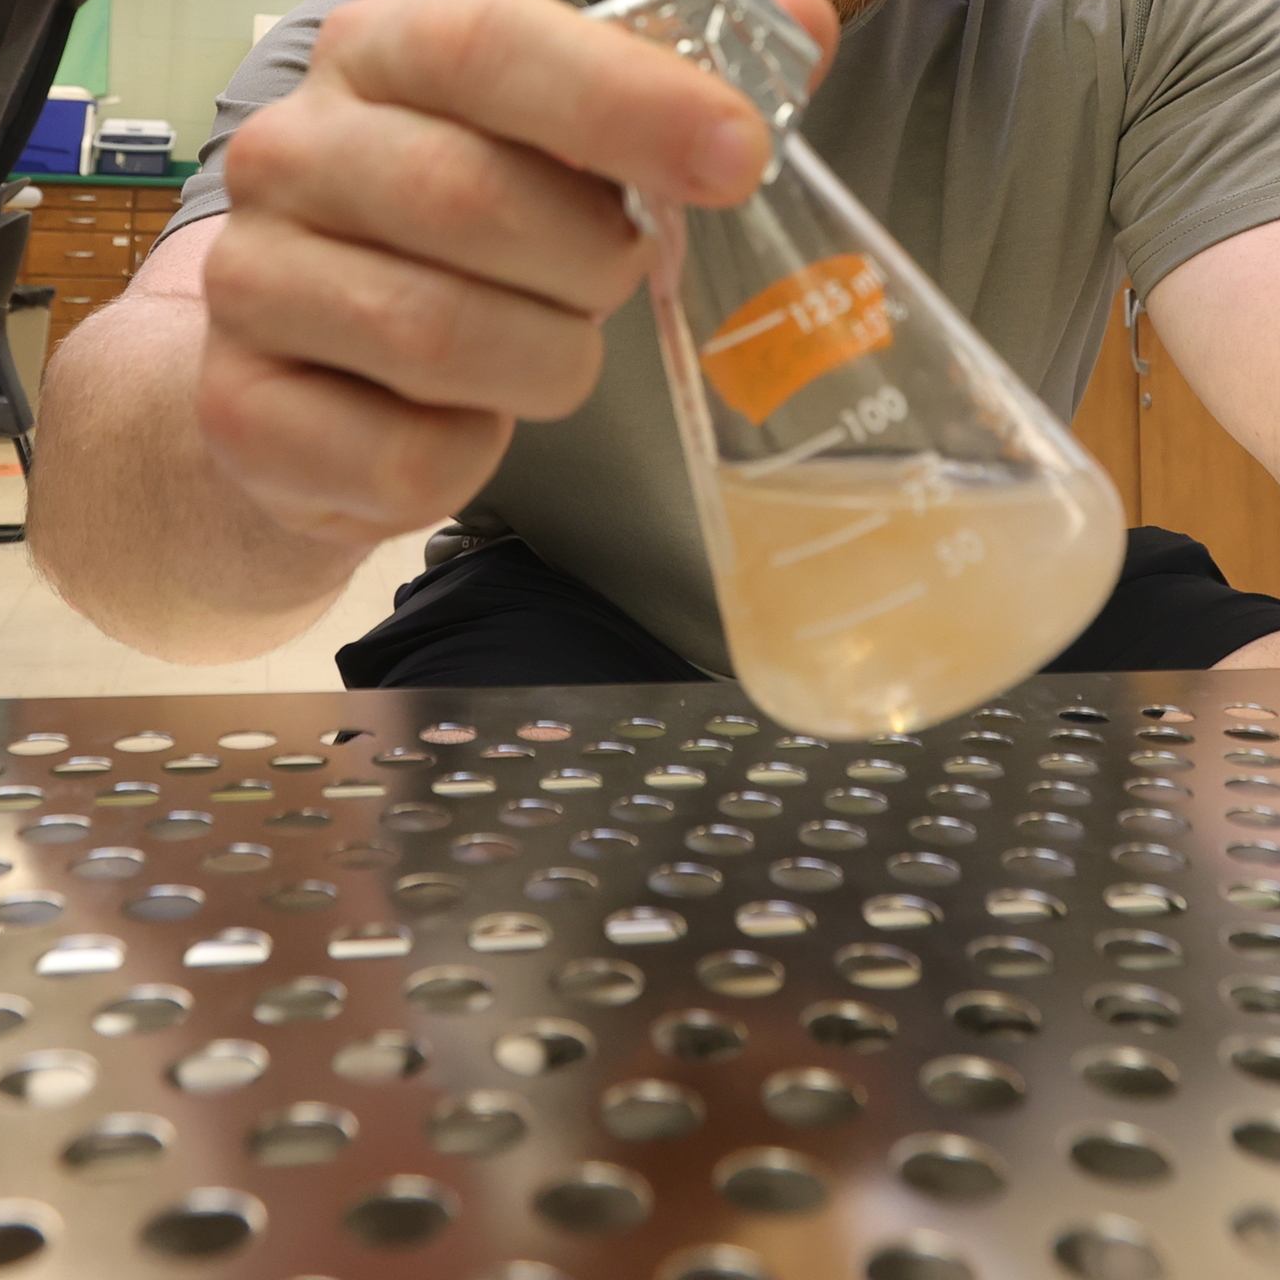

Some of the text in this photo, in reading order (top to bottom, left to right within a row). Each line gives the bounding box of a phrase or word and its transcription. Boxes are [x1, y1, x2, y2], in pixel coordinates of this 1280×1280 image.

[789, 278, 853, 335] 125
[840, 384, 909, 445] 100
[900, 466, 953, 519] 75
[934, 527, 985, 578] 50
